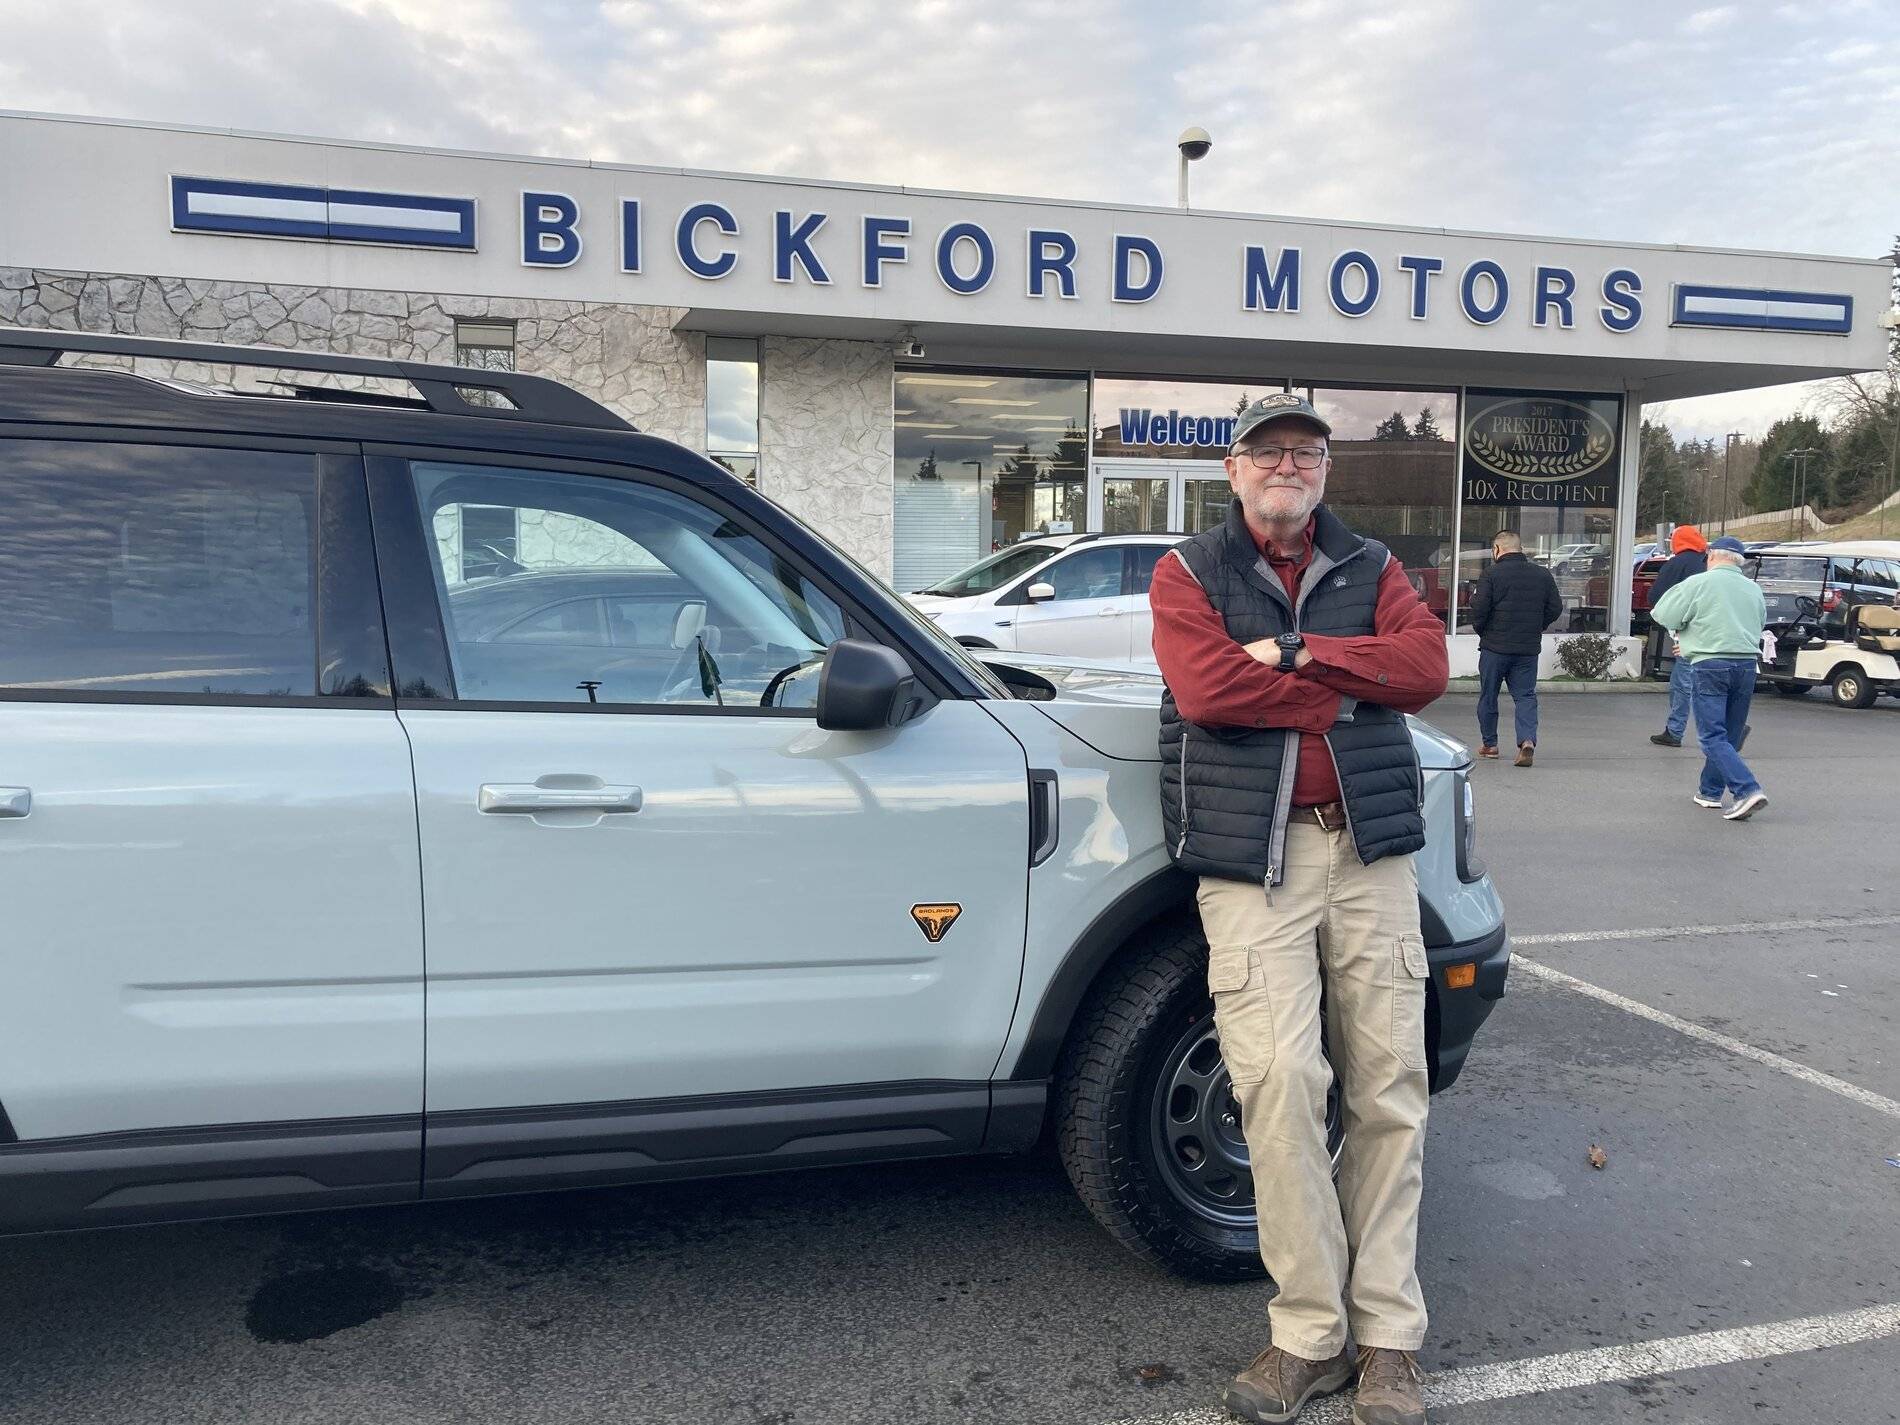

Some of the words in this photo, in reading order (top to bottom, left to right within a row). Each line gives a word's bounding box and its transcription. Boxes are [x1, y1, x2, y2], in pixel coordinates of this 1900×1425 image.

[520, 189, 1165, 304] BICKFORD
[1243, 244, 1644, 334] MOTORS
[1118, 407, 1239, 448] Welcom
[1491, 416, 1591, 436] PRESIDENT'S
[1511, 434, 1570, 453] AWARD
[1507, 480, 1610, 502] RECIPIENT
